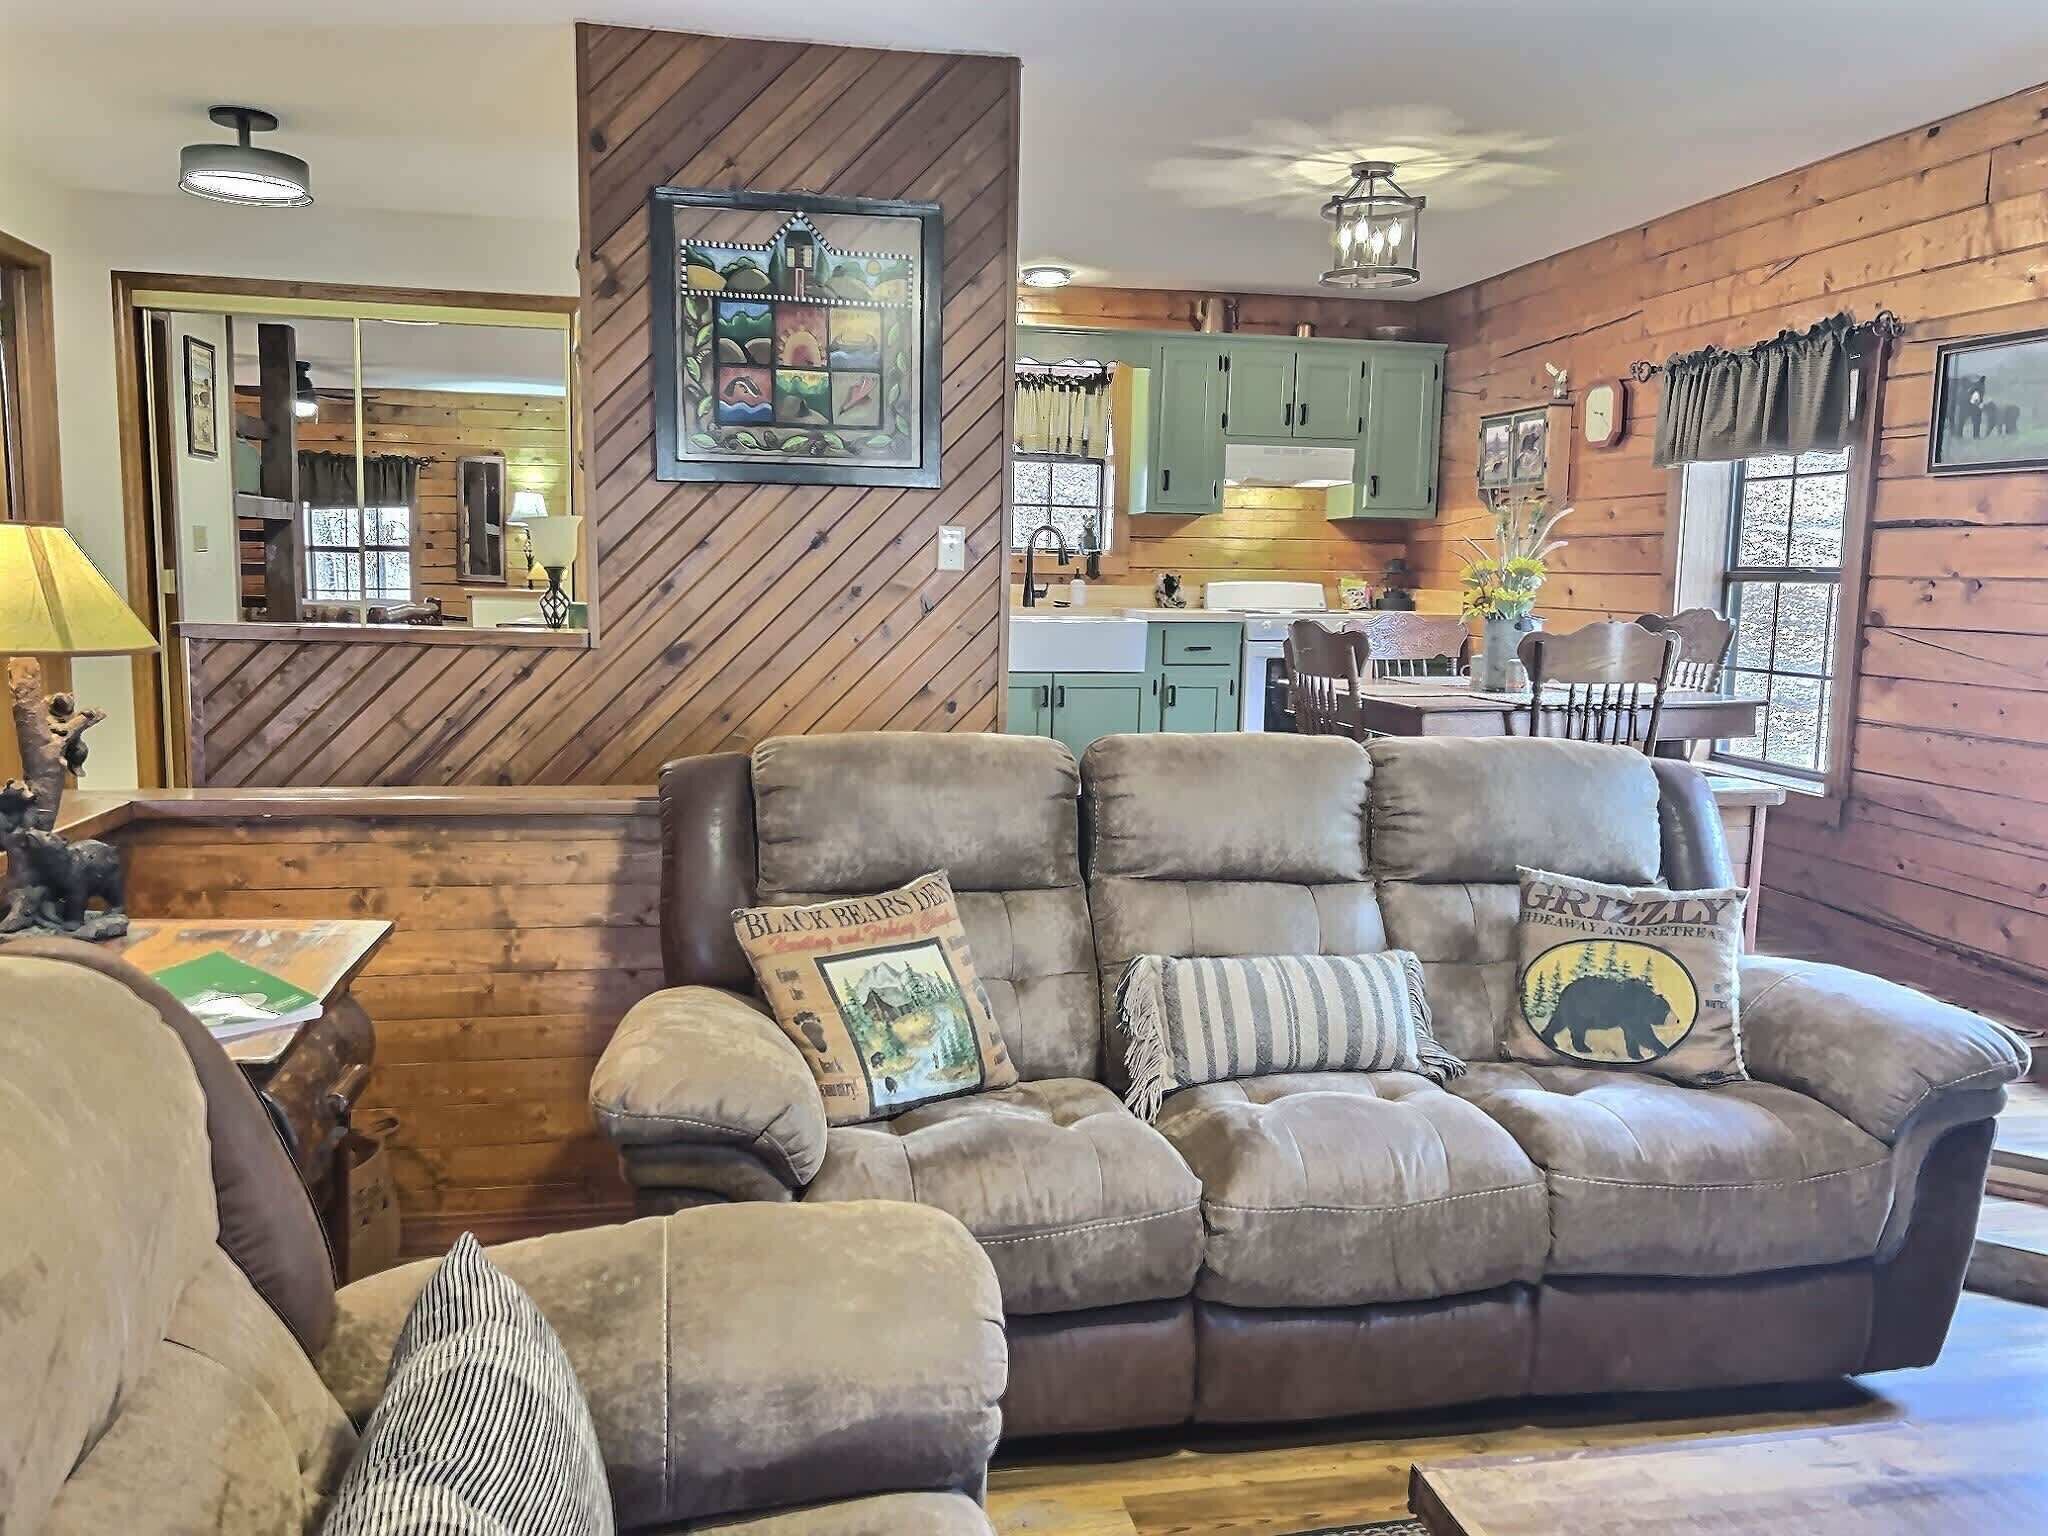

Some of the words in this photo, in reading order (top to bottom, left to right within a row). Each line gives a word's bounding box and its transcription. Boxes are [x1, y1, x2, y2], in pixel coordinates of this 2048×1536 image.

[744, 908, 831, 940] BLACK
[831, 895, 913, 928] BEARS
[1520, 881, 1732, 926] GRIZZLY
[1603, 926, 1641, 937] AND
